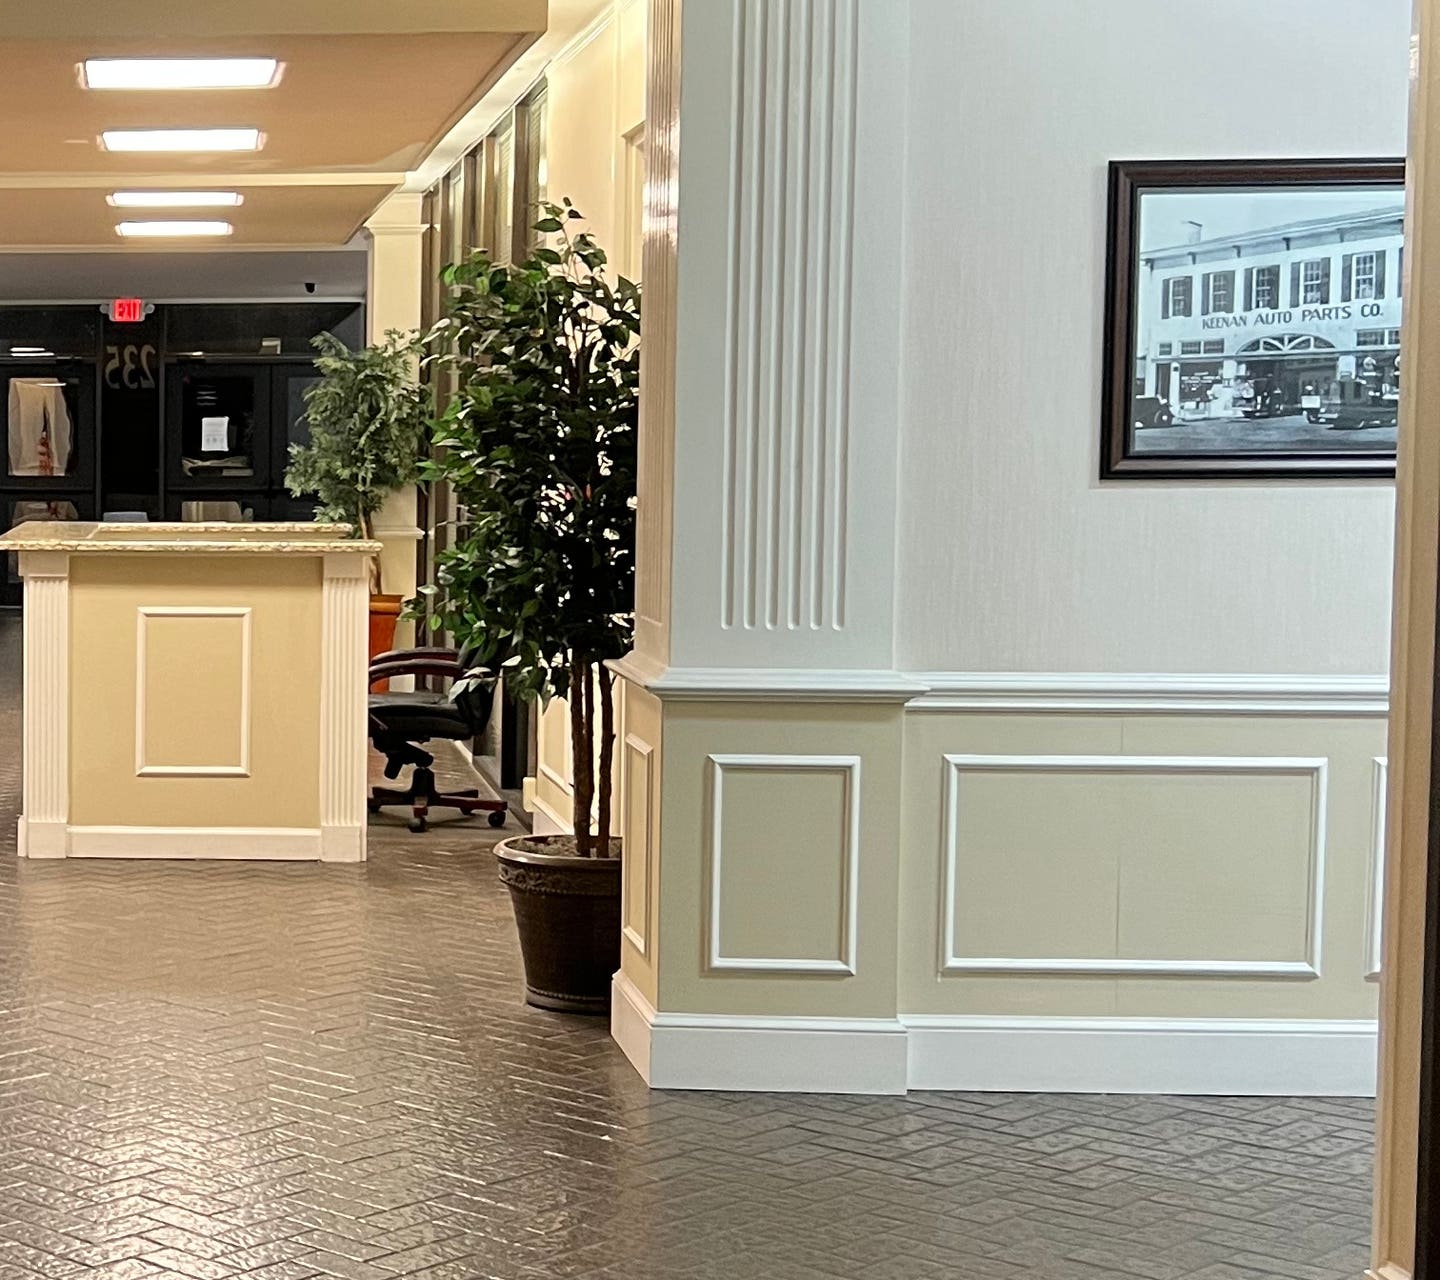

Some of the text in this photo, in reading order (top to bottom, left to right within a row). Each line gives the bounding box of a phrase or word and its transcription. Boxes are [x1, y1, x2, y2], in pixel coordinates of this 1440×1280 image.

[115, 302, 140, 320] EXIT
[1202, 303, 1384, 329] KEENAN AUTO PARTS CO.
